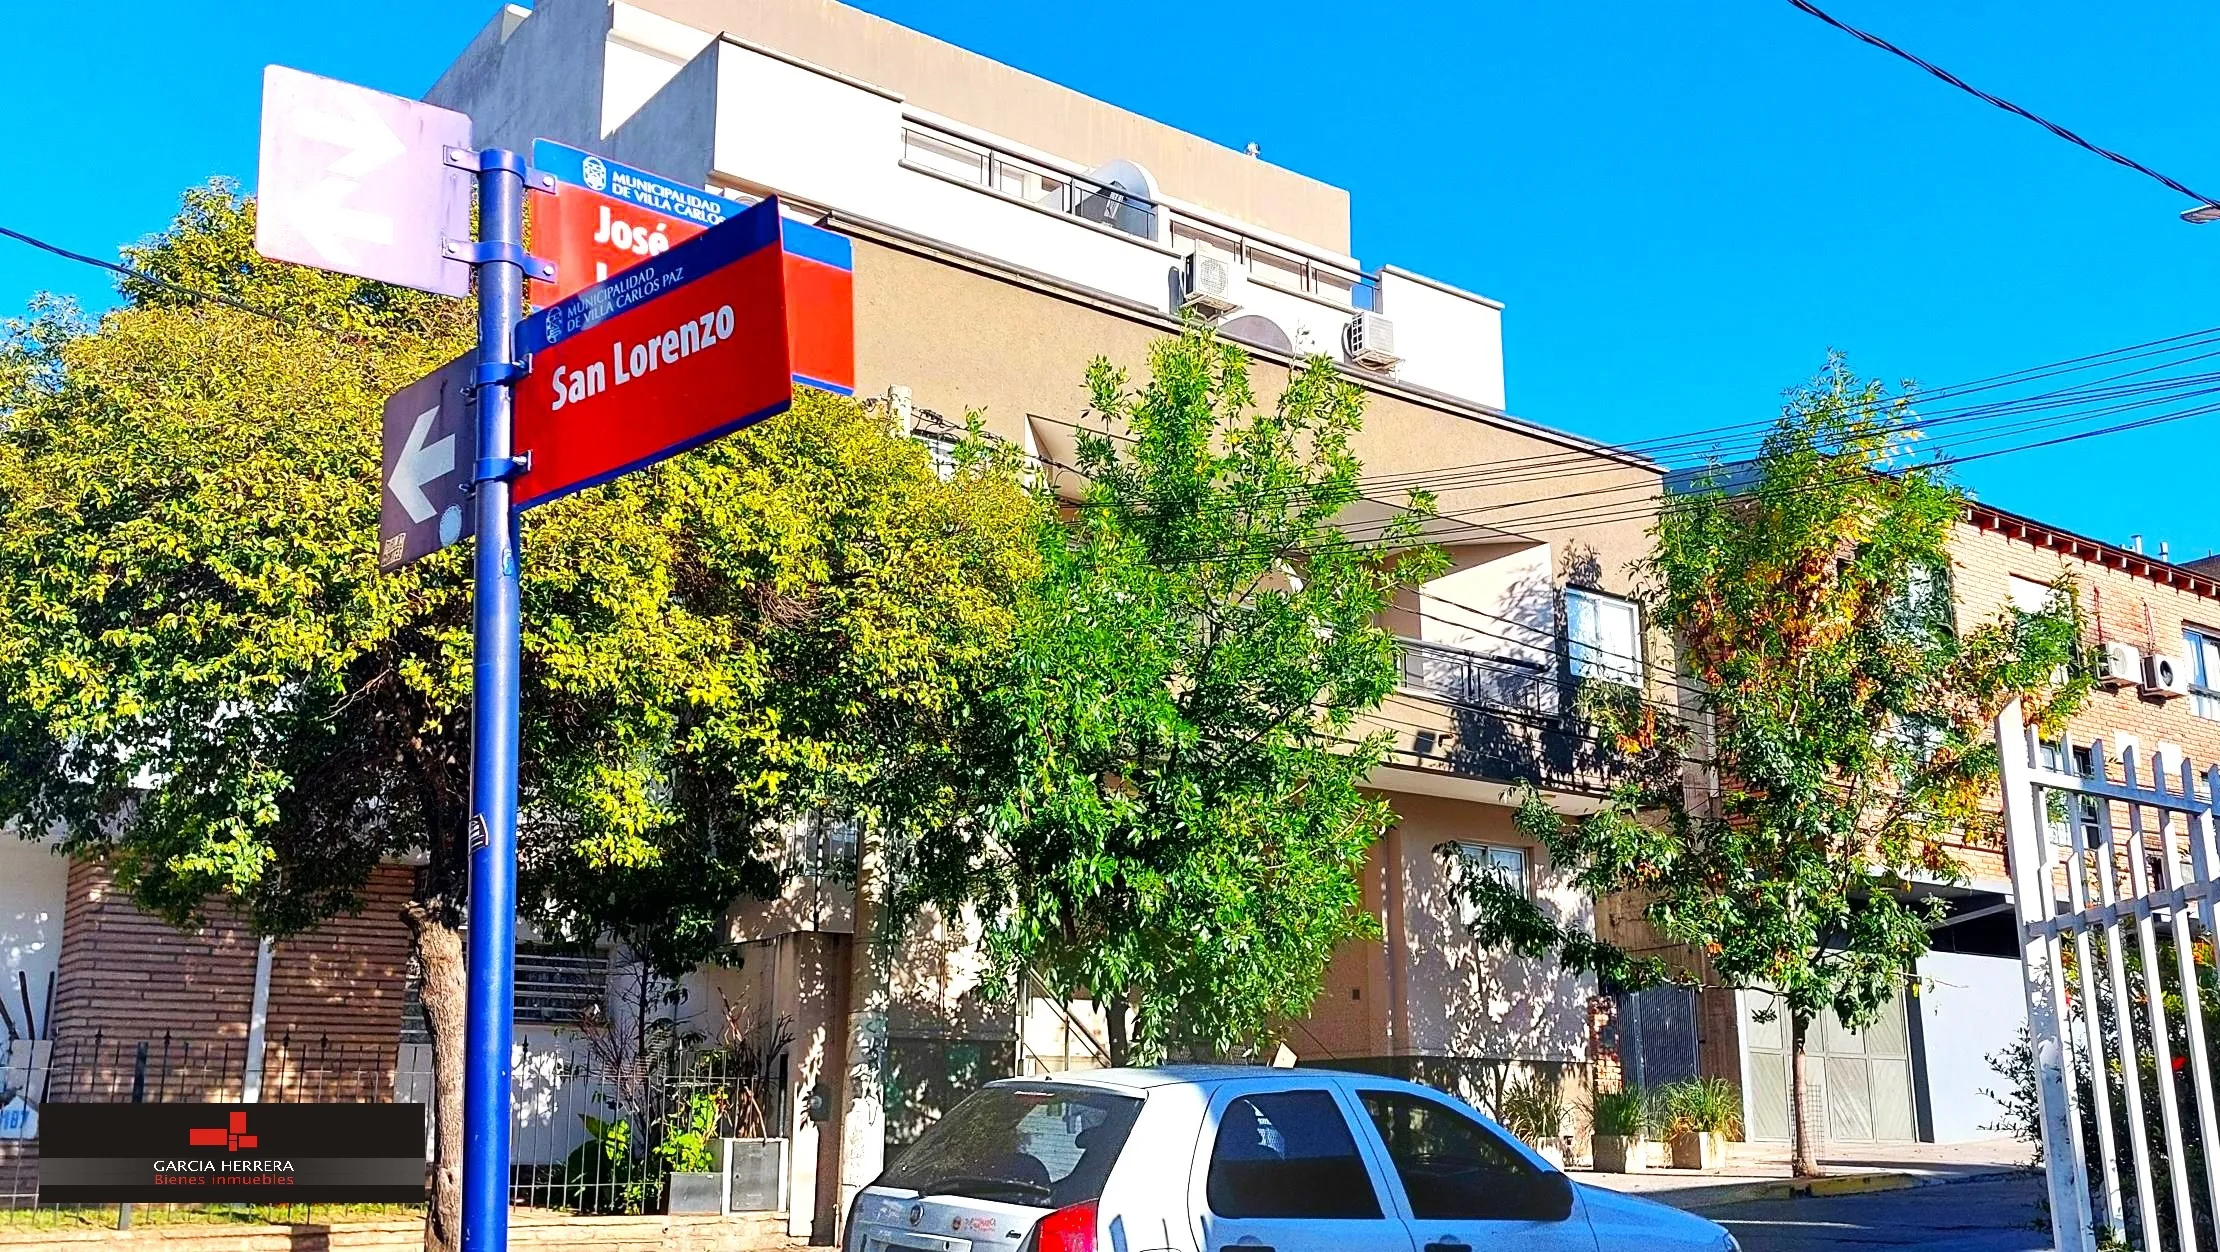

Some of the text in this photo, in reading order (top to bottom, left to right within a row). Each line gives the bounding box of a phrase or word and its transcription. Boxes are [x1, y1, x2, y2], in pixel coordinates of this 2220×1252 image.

[611, 170, 721, 214] MUNICIPALIDAD
[611, 184, 631, 199] DE
[634, 189, 672, 212] VILLA
[594, 205, 670, 257] José
[567, 267, 655, 319] MUNICIPALIDAD
[567, 267, 685, 333] DE VILLA CARLOS PAZ
[551, 304, 736, 412] San Lorenzo
